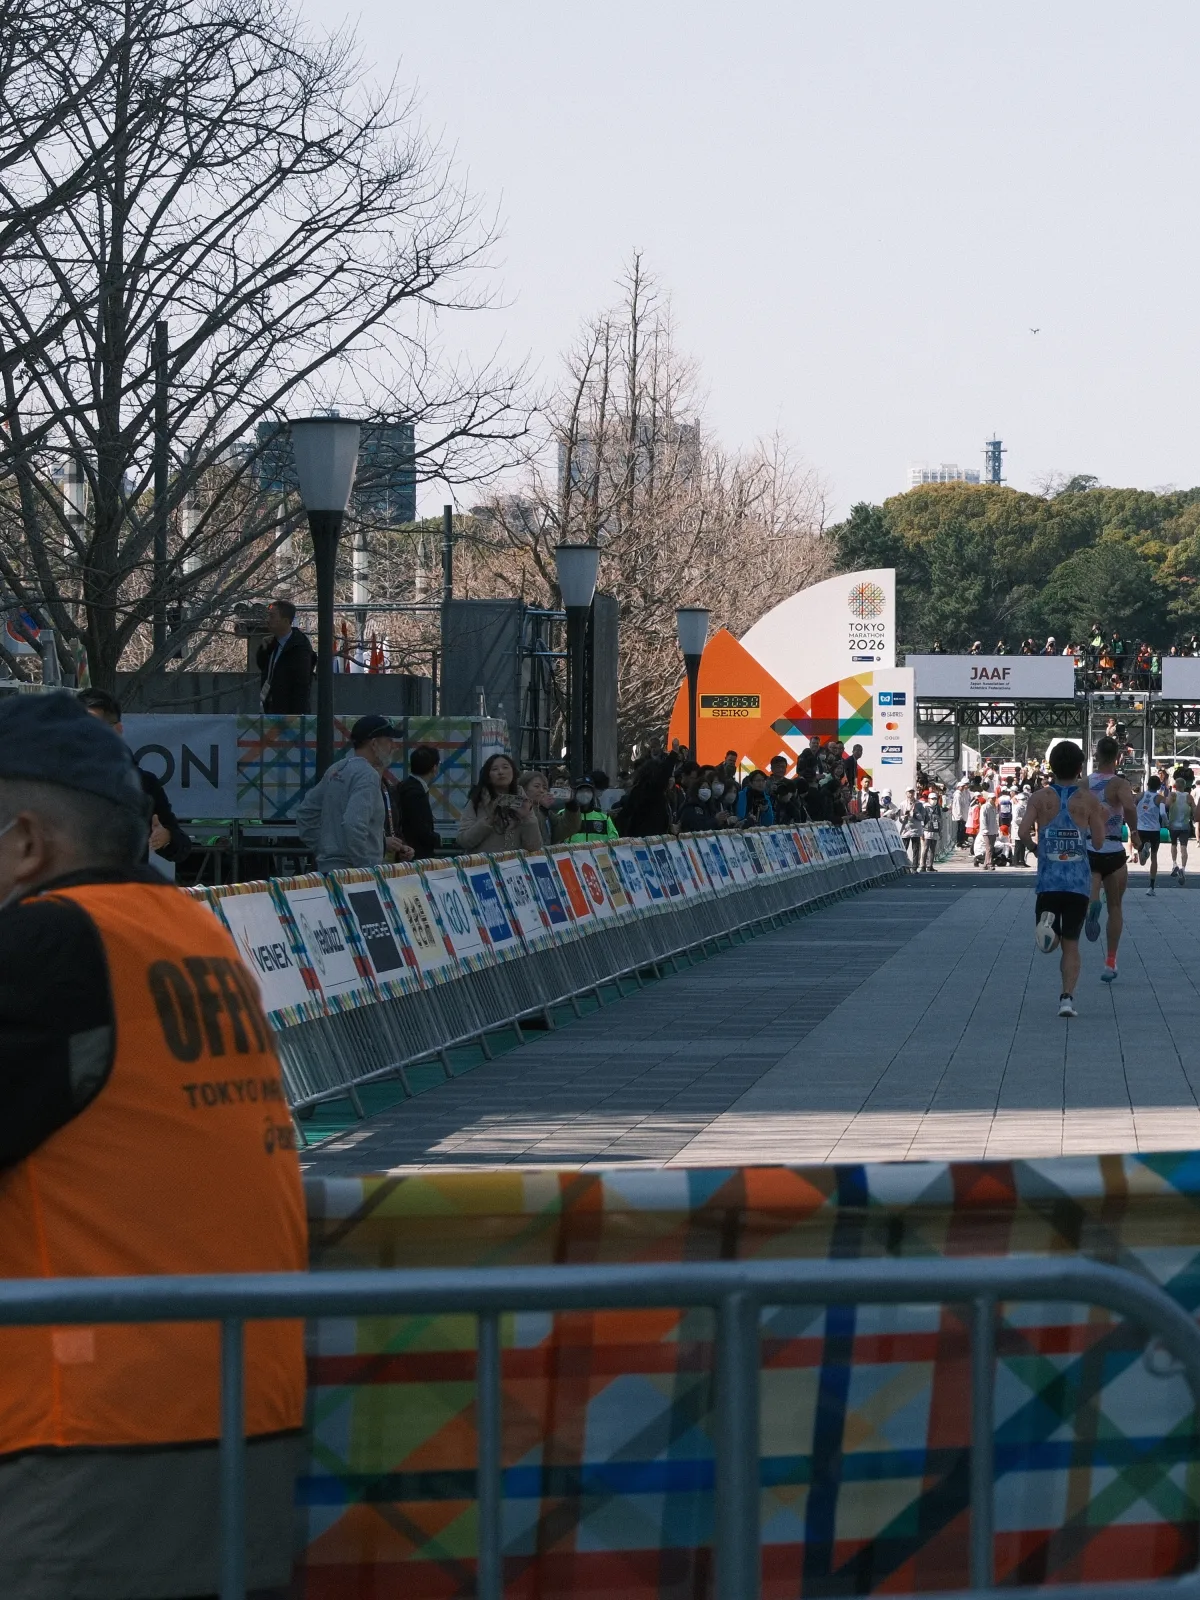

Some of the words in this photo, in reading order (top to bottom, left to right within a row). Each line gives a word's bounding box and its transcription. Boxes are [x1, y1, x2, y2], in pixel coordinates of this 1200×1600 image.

[848, 623, 885, 632] TOKYO
[848, 640, 885, 650] 2026
[970, 667, 1011, 680] JAAF
[712, 696, 758, 707] 2:30:50
[712, 709, 749, 717] SEIKO
[1053, 840, 1075, 850] 3019
[361, 922, 390, 939] PORSCHE
[252, 941, 293, 973] VENEX
[183, 1079, 257, 1109] TOKYO
